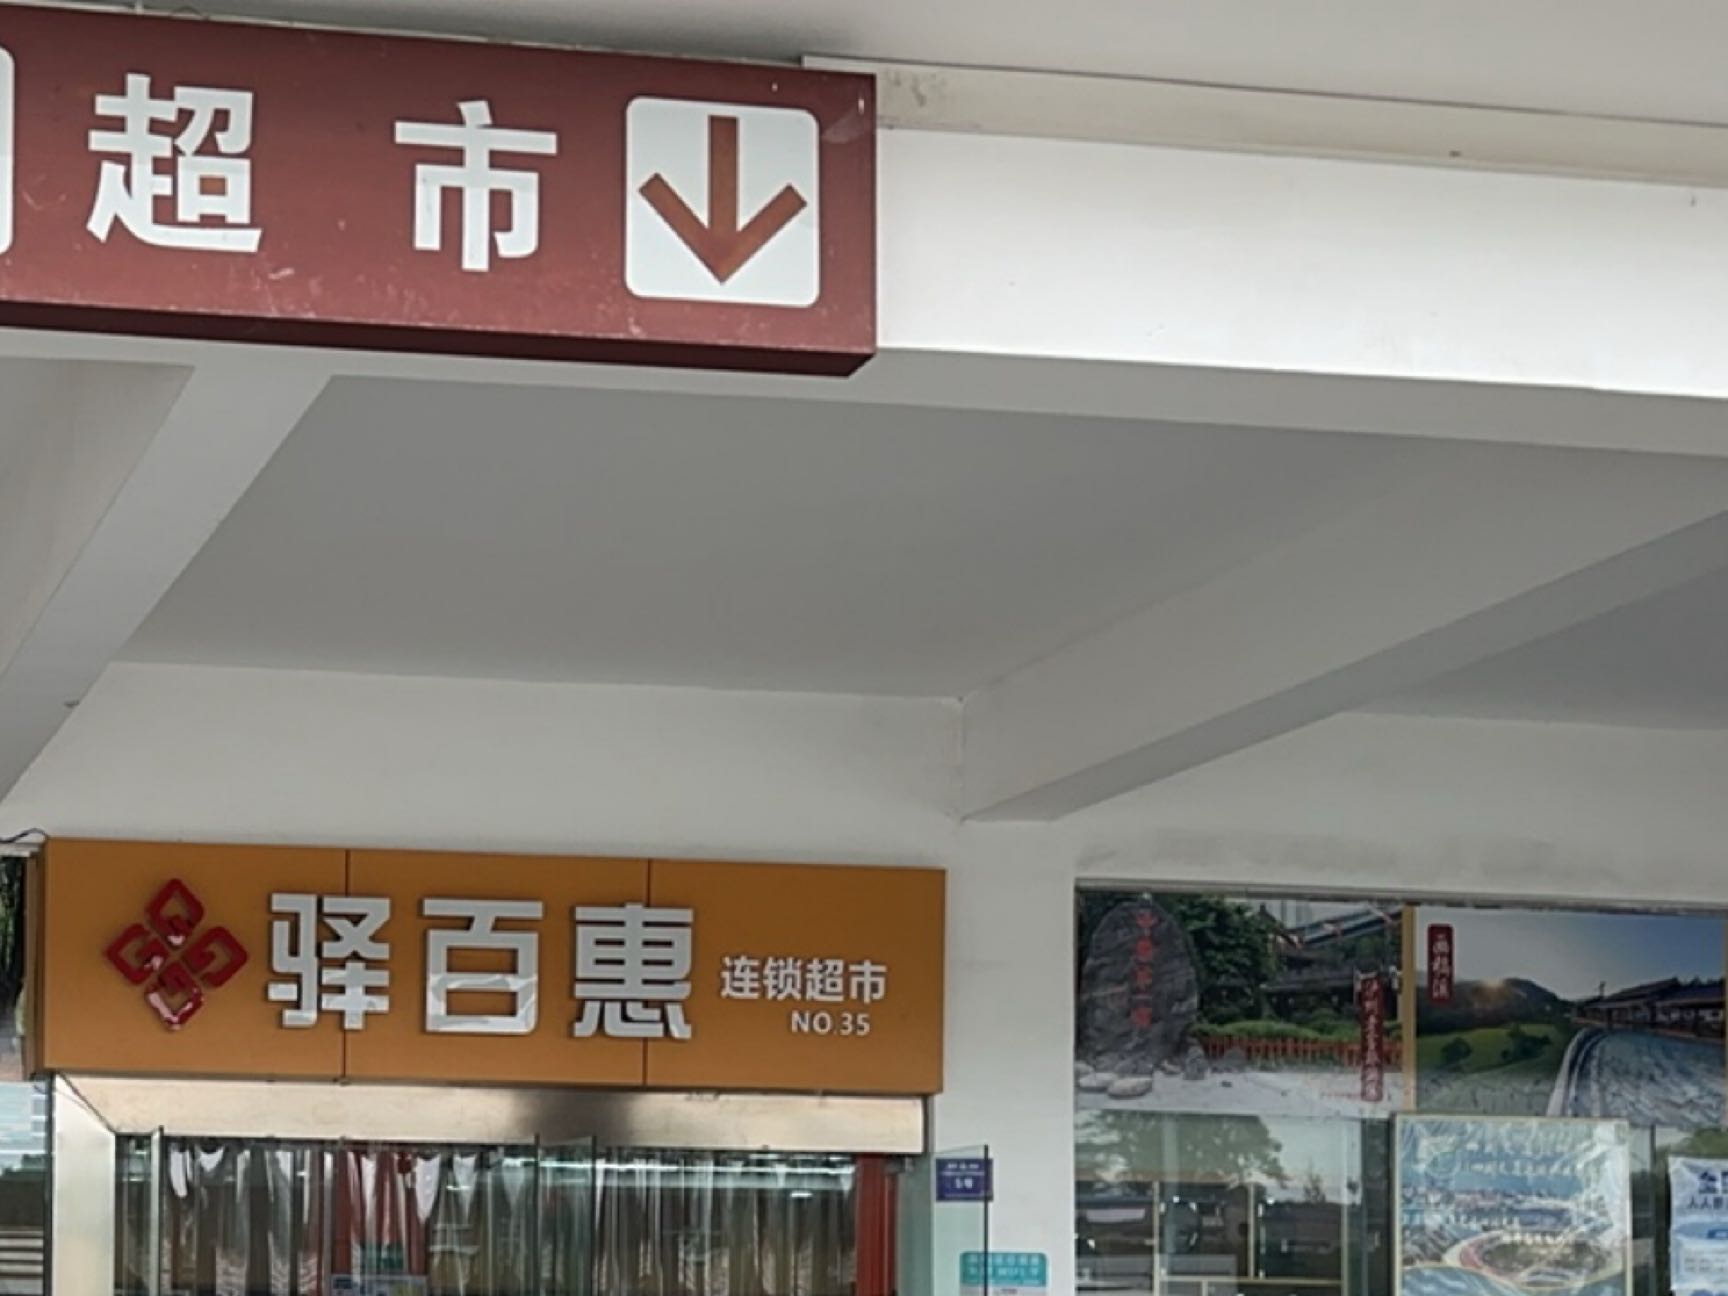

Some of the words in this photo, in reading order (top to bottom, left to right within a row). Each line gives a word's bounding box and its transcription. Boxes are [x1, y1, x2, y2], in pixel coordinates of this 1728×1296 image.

[87, 74, 558, 273] 超市
[267, 892, 693, 1041] 驿百惠
[721, 955, 887, 1003] 连锁超市
